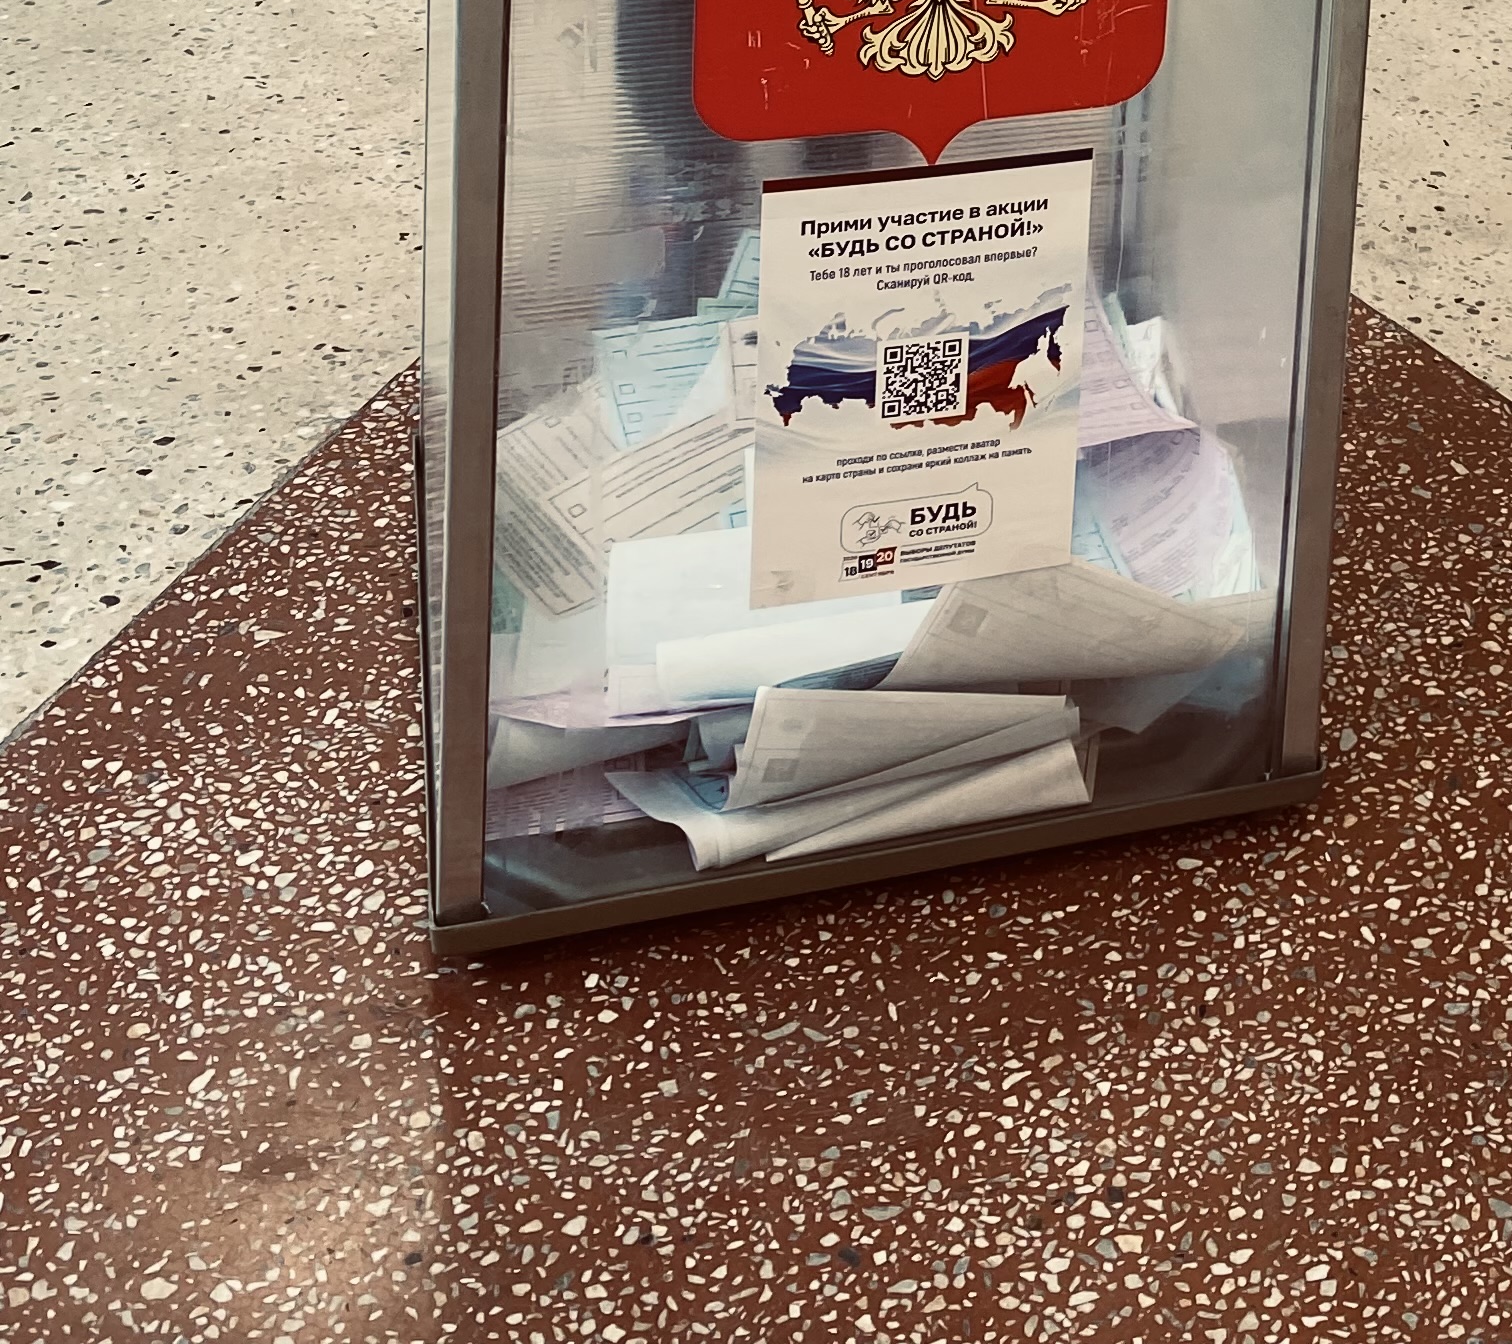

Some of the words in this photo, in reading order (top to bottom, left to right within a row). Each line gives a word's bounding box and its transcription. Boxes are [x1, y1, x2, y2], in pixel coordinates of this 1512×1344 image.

[800, 217, 873, 240] Прими
[877, 207, 965, 234] участие
[969, 205, 982, 219] в
[985, 198, 1049, 216] акции
[808, 241, 880, 260] «БУДЬ
[884, 234, 917, 251] СО
[921, 217, 1044, 248] СТРАНОЙ!»
[809, 268, 837, 282] Тебе
[838, 267, 851, 279] 18
[852, 264, 873, 278] лет
[875, 264, 883, 275] и
[885, 262, 901, 274] ты
[903, 253, 982, 273] проголосовал
[984, 247, 1038, 263] впервые?
[876, 274, 930, 292] Сканируй
[802, 475, 814, 484] на
[842, 467, 877, 479] страны
[878, 466, 885, 475] и
[886, 461, 923, 474] сохрани
[925, 456, 952, 470] яркий
[953, 453, 987, 465] коллаж
[988, 451, 1000, 460] на
[1001, 447, 1033, 458] память
[836, 455, 874, 468] проходи
[876, 454, 888, 462] по
[926, 443, 969, 457] размести
[970, 438, 1001, 449] аватар
[910, 500, 977, 526] БУДЬ
[908, 528, 924, 538] СО
[925, 520, 978, 536] СТРАНОЙ!
[843, 566, 858, 577] 18
[860, 558, 874, 570] 19
[876, 550, 894, 563] 20
